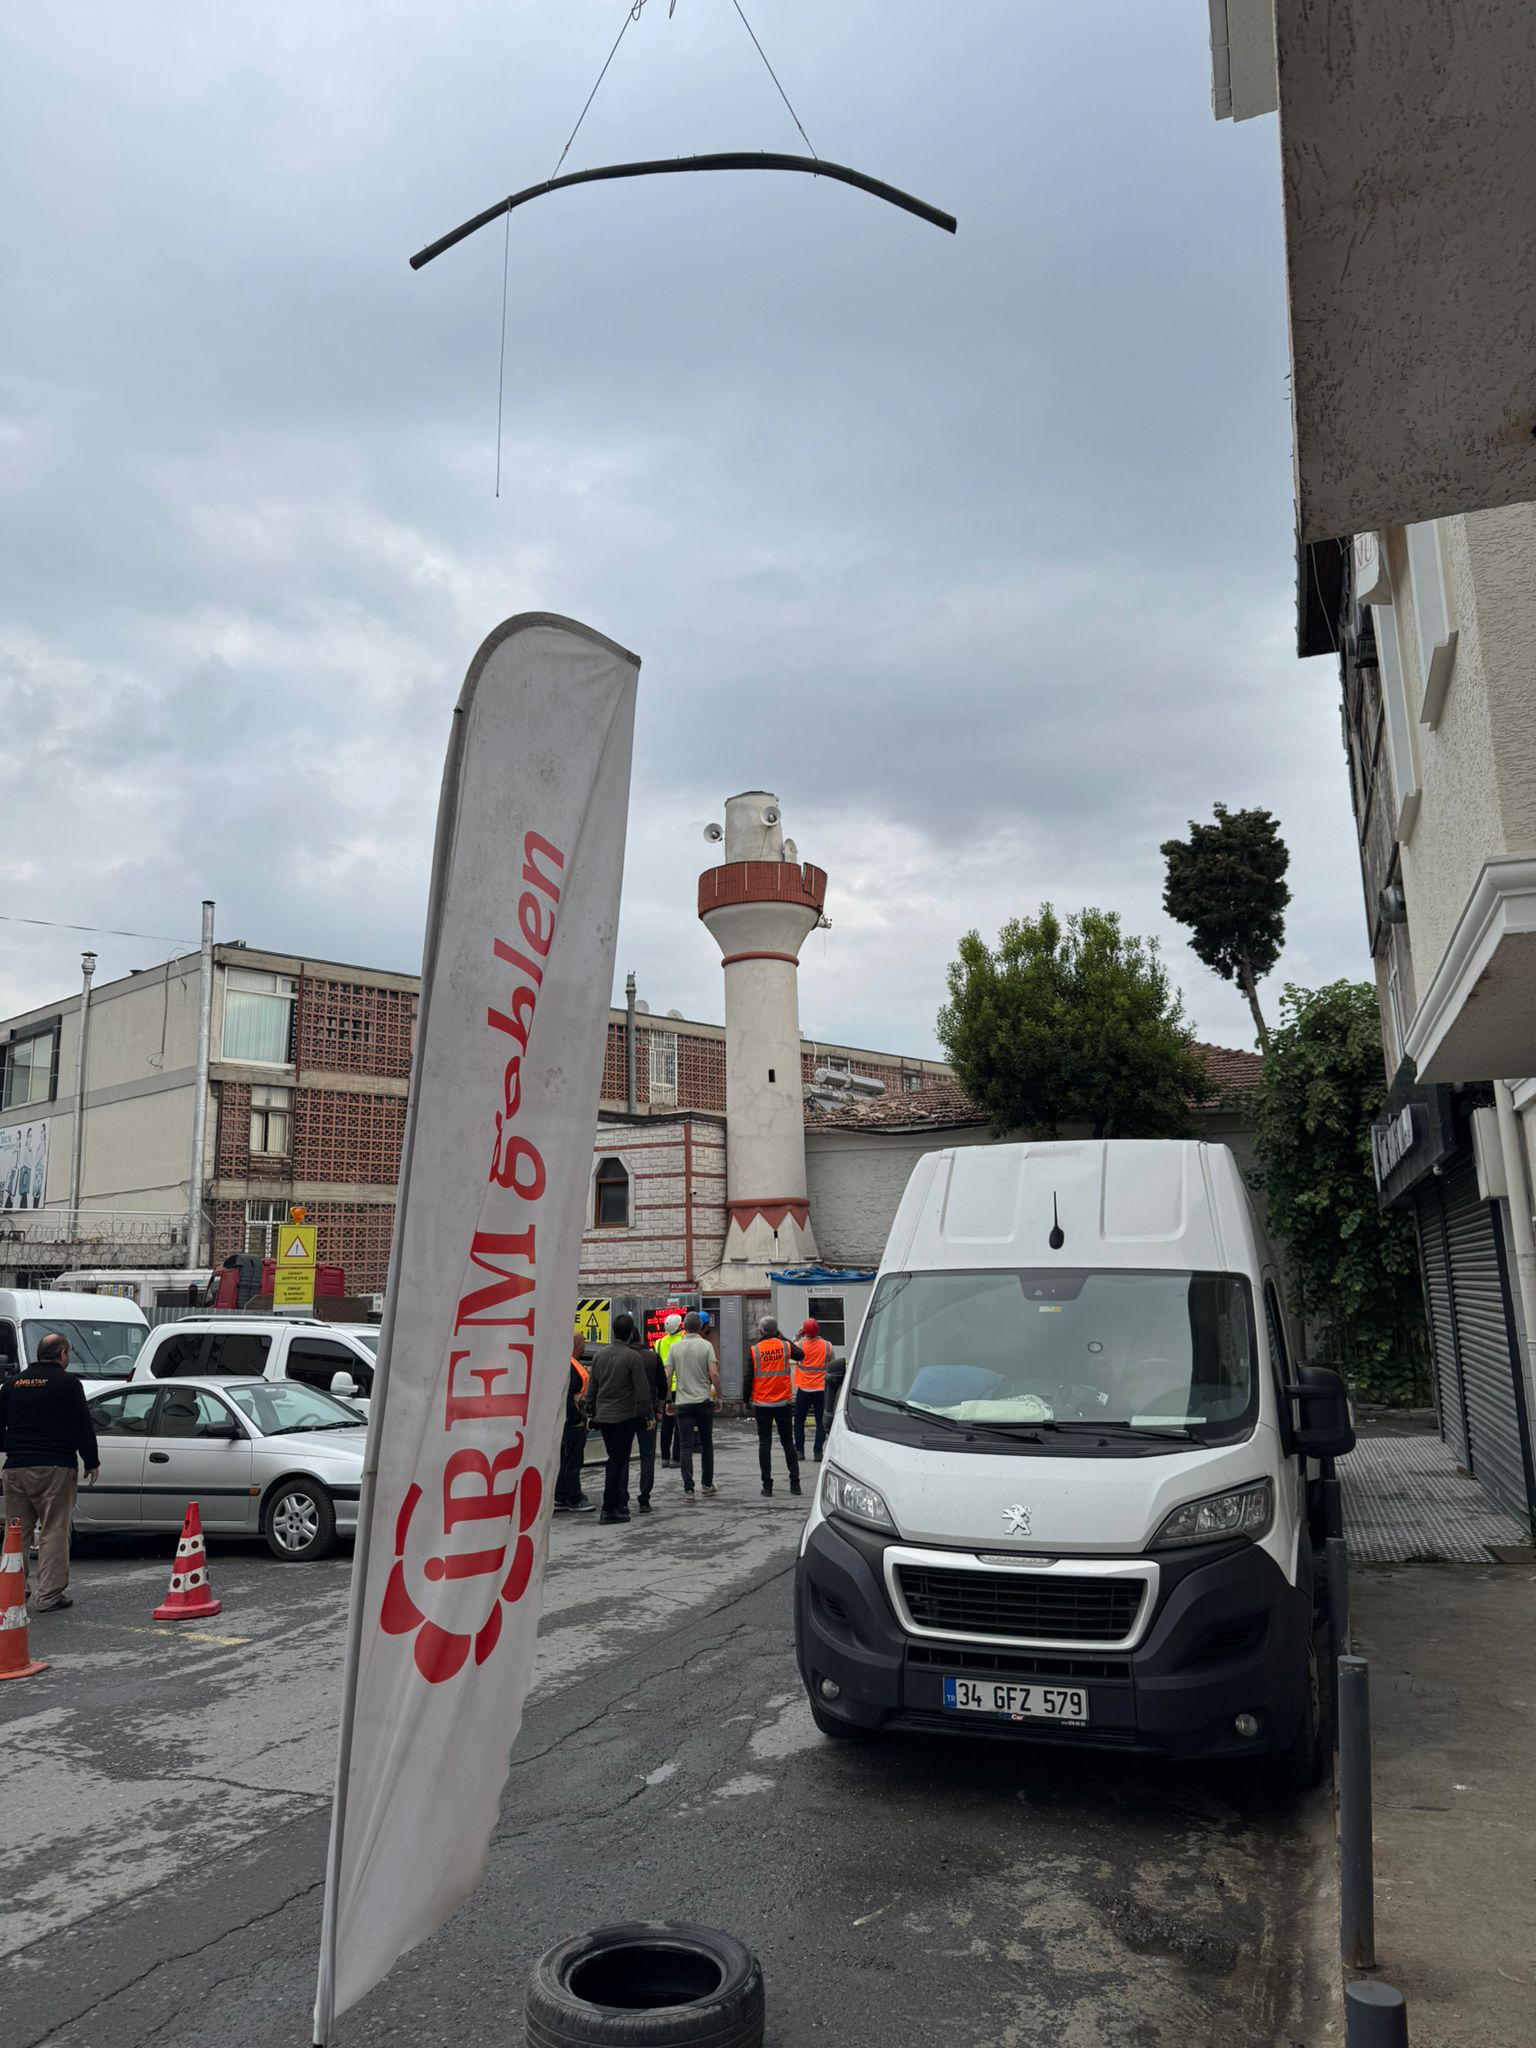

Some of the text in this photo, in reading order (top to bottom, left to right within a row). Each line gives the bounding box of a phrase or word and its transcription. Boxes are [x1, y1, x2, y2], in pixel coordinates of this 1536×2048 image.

[763, 1354, 783, 1362] GRUP
[946, 1683, 1082, 1716] TR 34 GFZ 579
